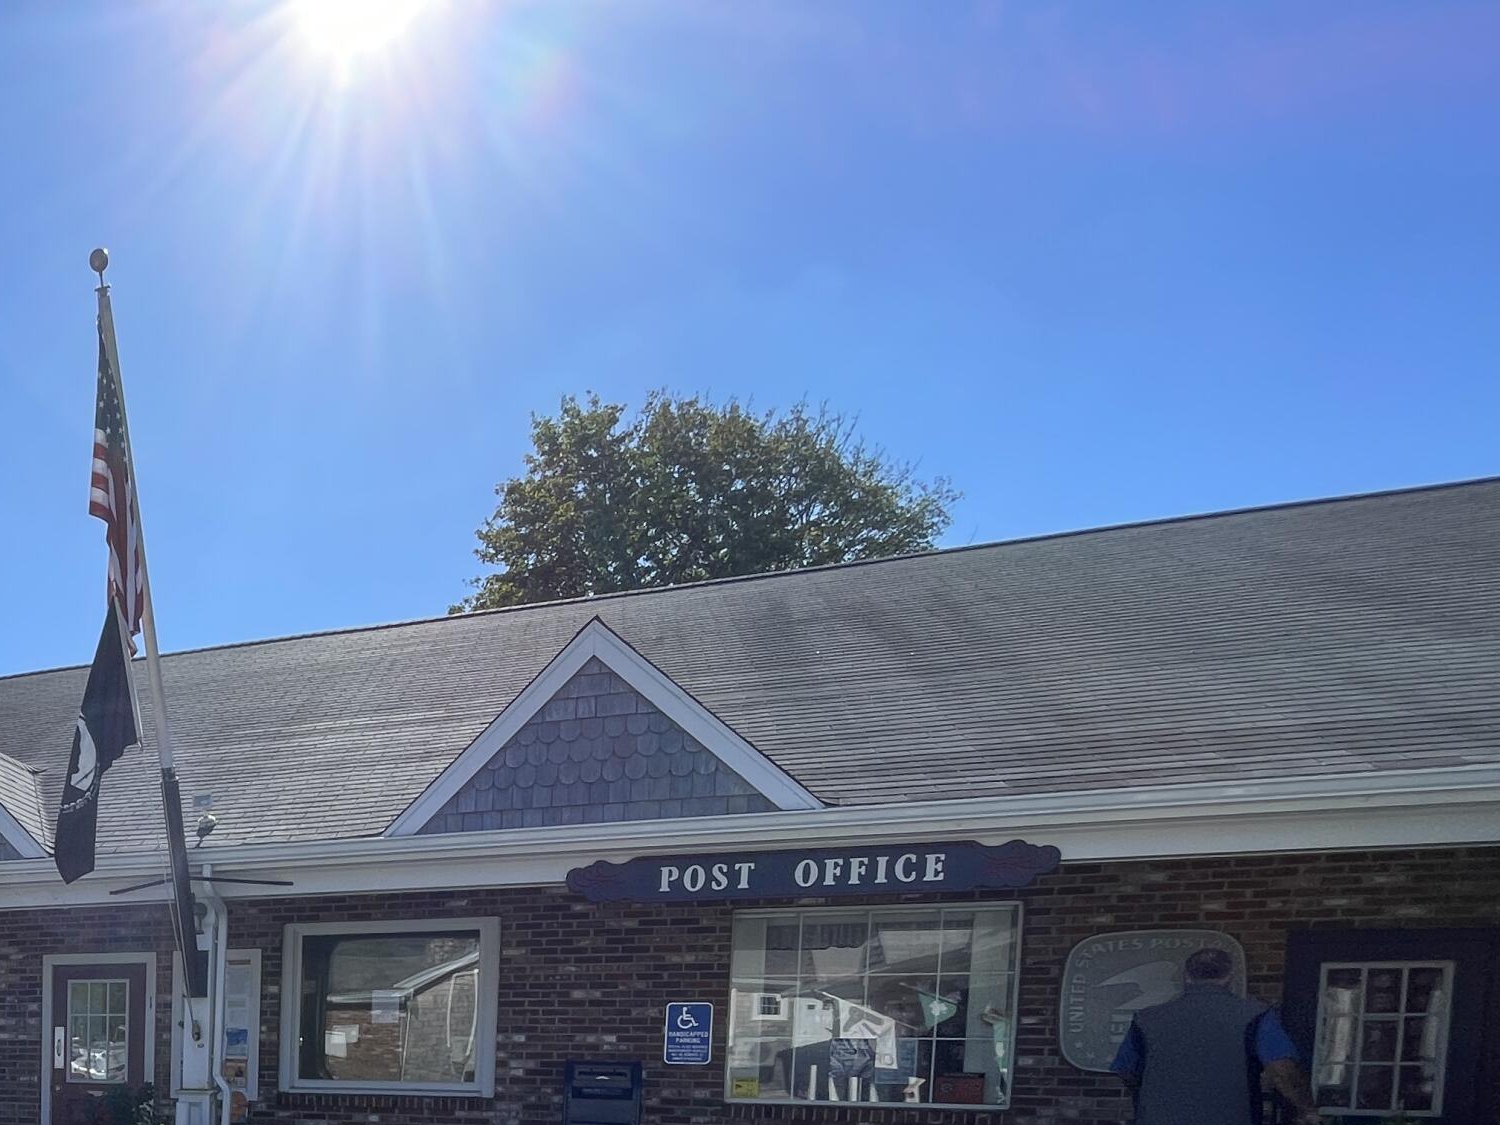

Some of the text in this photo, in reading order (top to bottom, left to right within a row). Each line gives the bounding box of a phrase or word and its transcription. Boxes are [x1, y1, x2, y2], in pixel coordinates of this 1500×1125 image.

[659, 853, 946, 892] POST OFFICE
[1075, 937, 1143, 969] STATES
[1068, 974, 1087, 1034] UNITED
